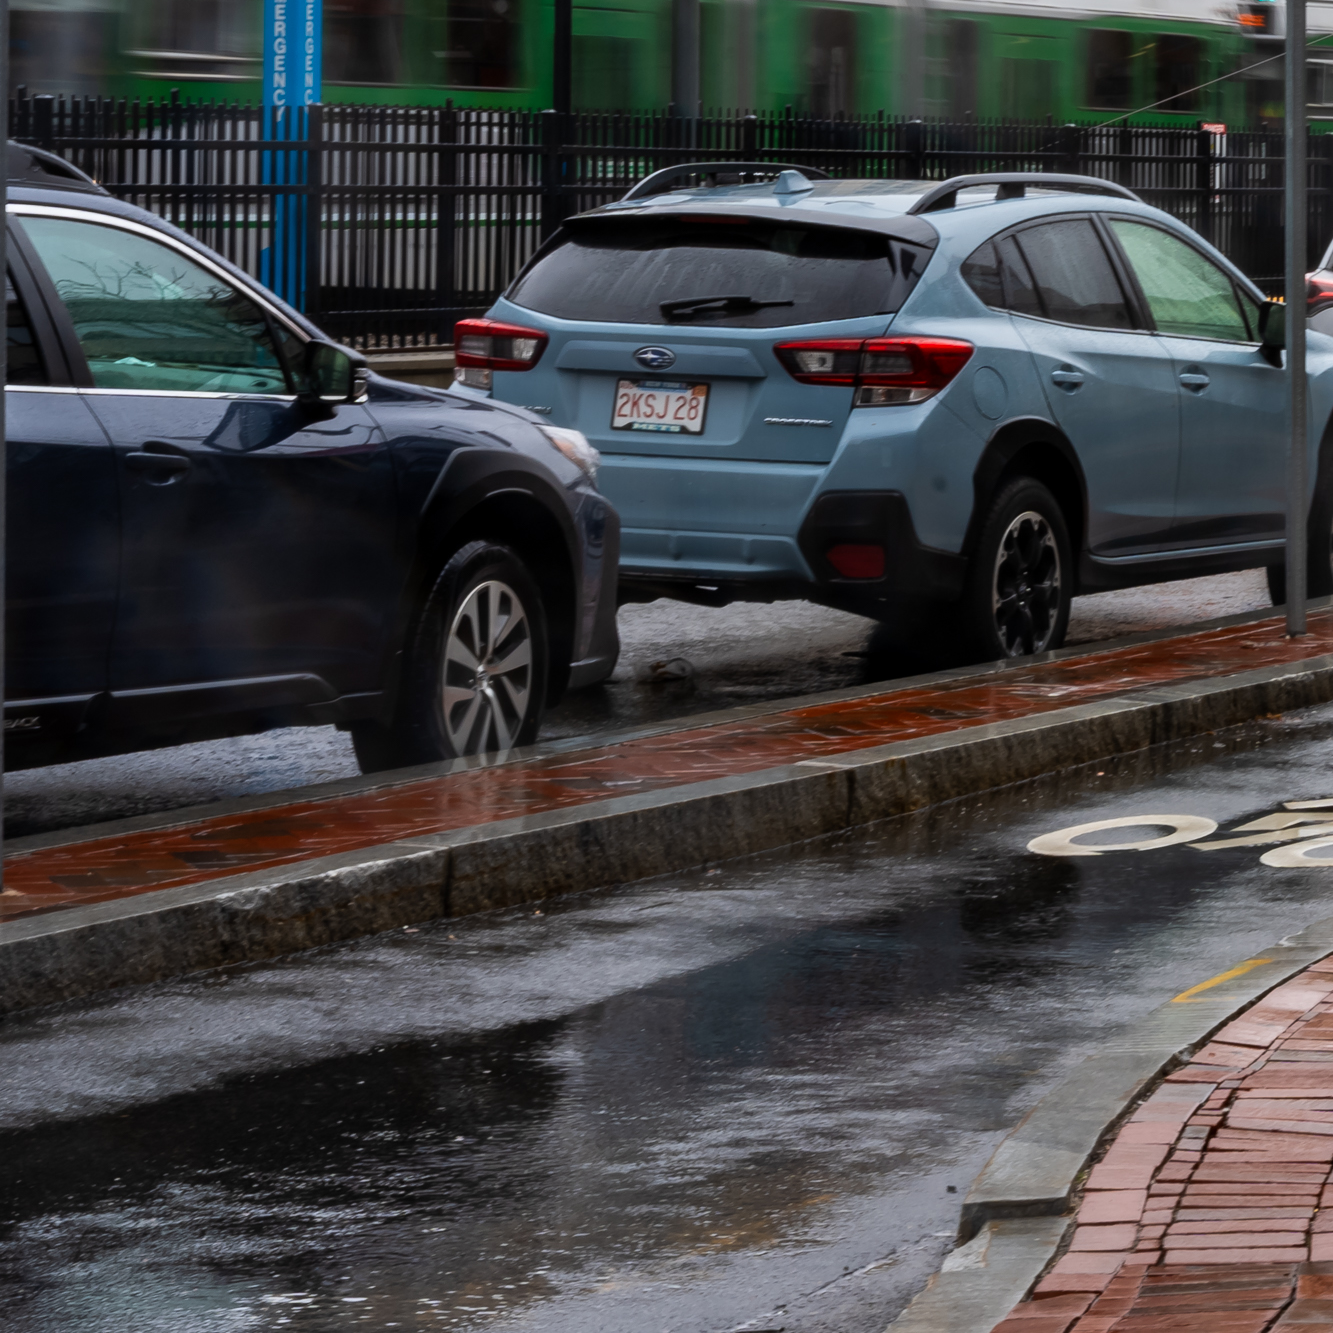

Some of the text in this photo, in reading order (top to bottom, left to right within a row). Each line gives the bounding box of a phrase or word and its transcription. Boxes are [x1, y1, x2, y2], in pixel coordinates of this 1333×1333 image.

[617, 392, 700, 421] 2KSJ 28
[631, 423, 681, 433] METS
